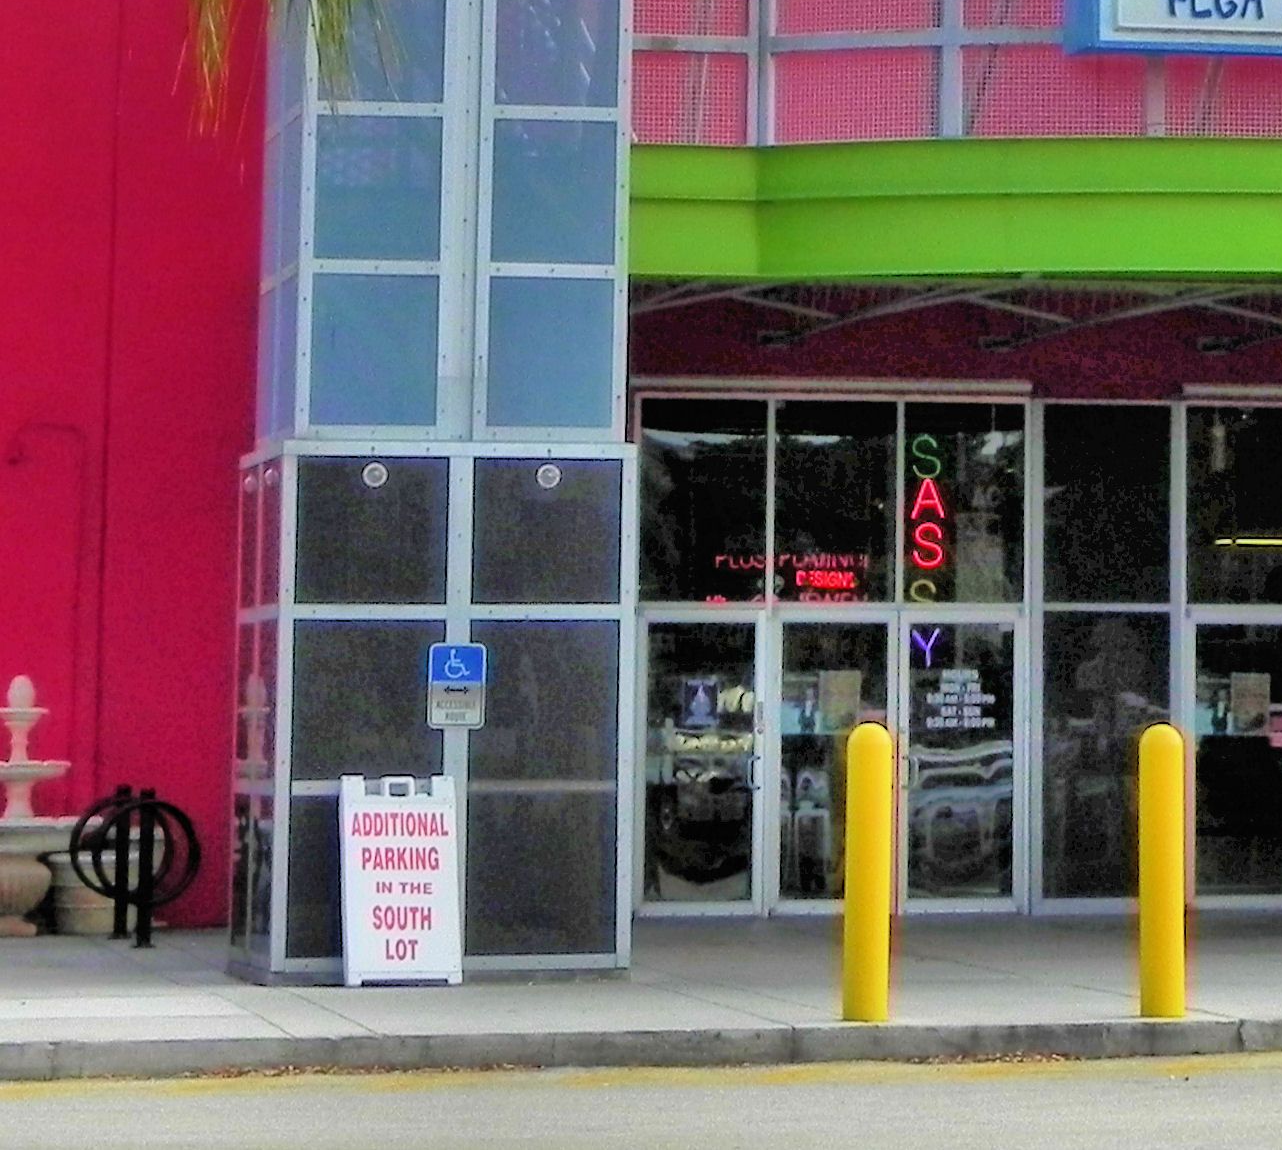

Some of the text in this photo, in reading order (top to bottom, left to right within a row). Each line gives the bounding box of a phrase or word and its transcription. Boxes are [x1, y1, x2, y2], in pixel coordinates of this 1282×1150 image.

[351, 812, 449, 837] ADDITIONAL
[361, 847, 440, 871] PARKING
[376, 882, 433, 894] IN THE
[372, 906, 432, 930] SOUTH
[385, 939, 418, 961] LOT
